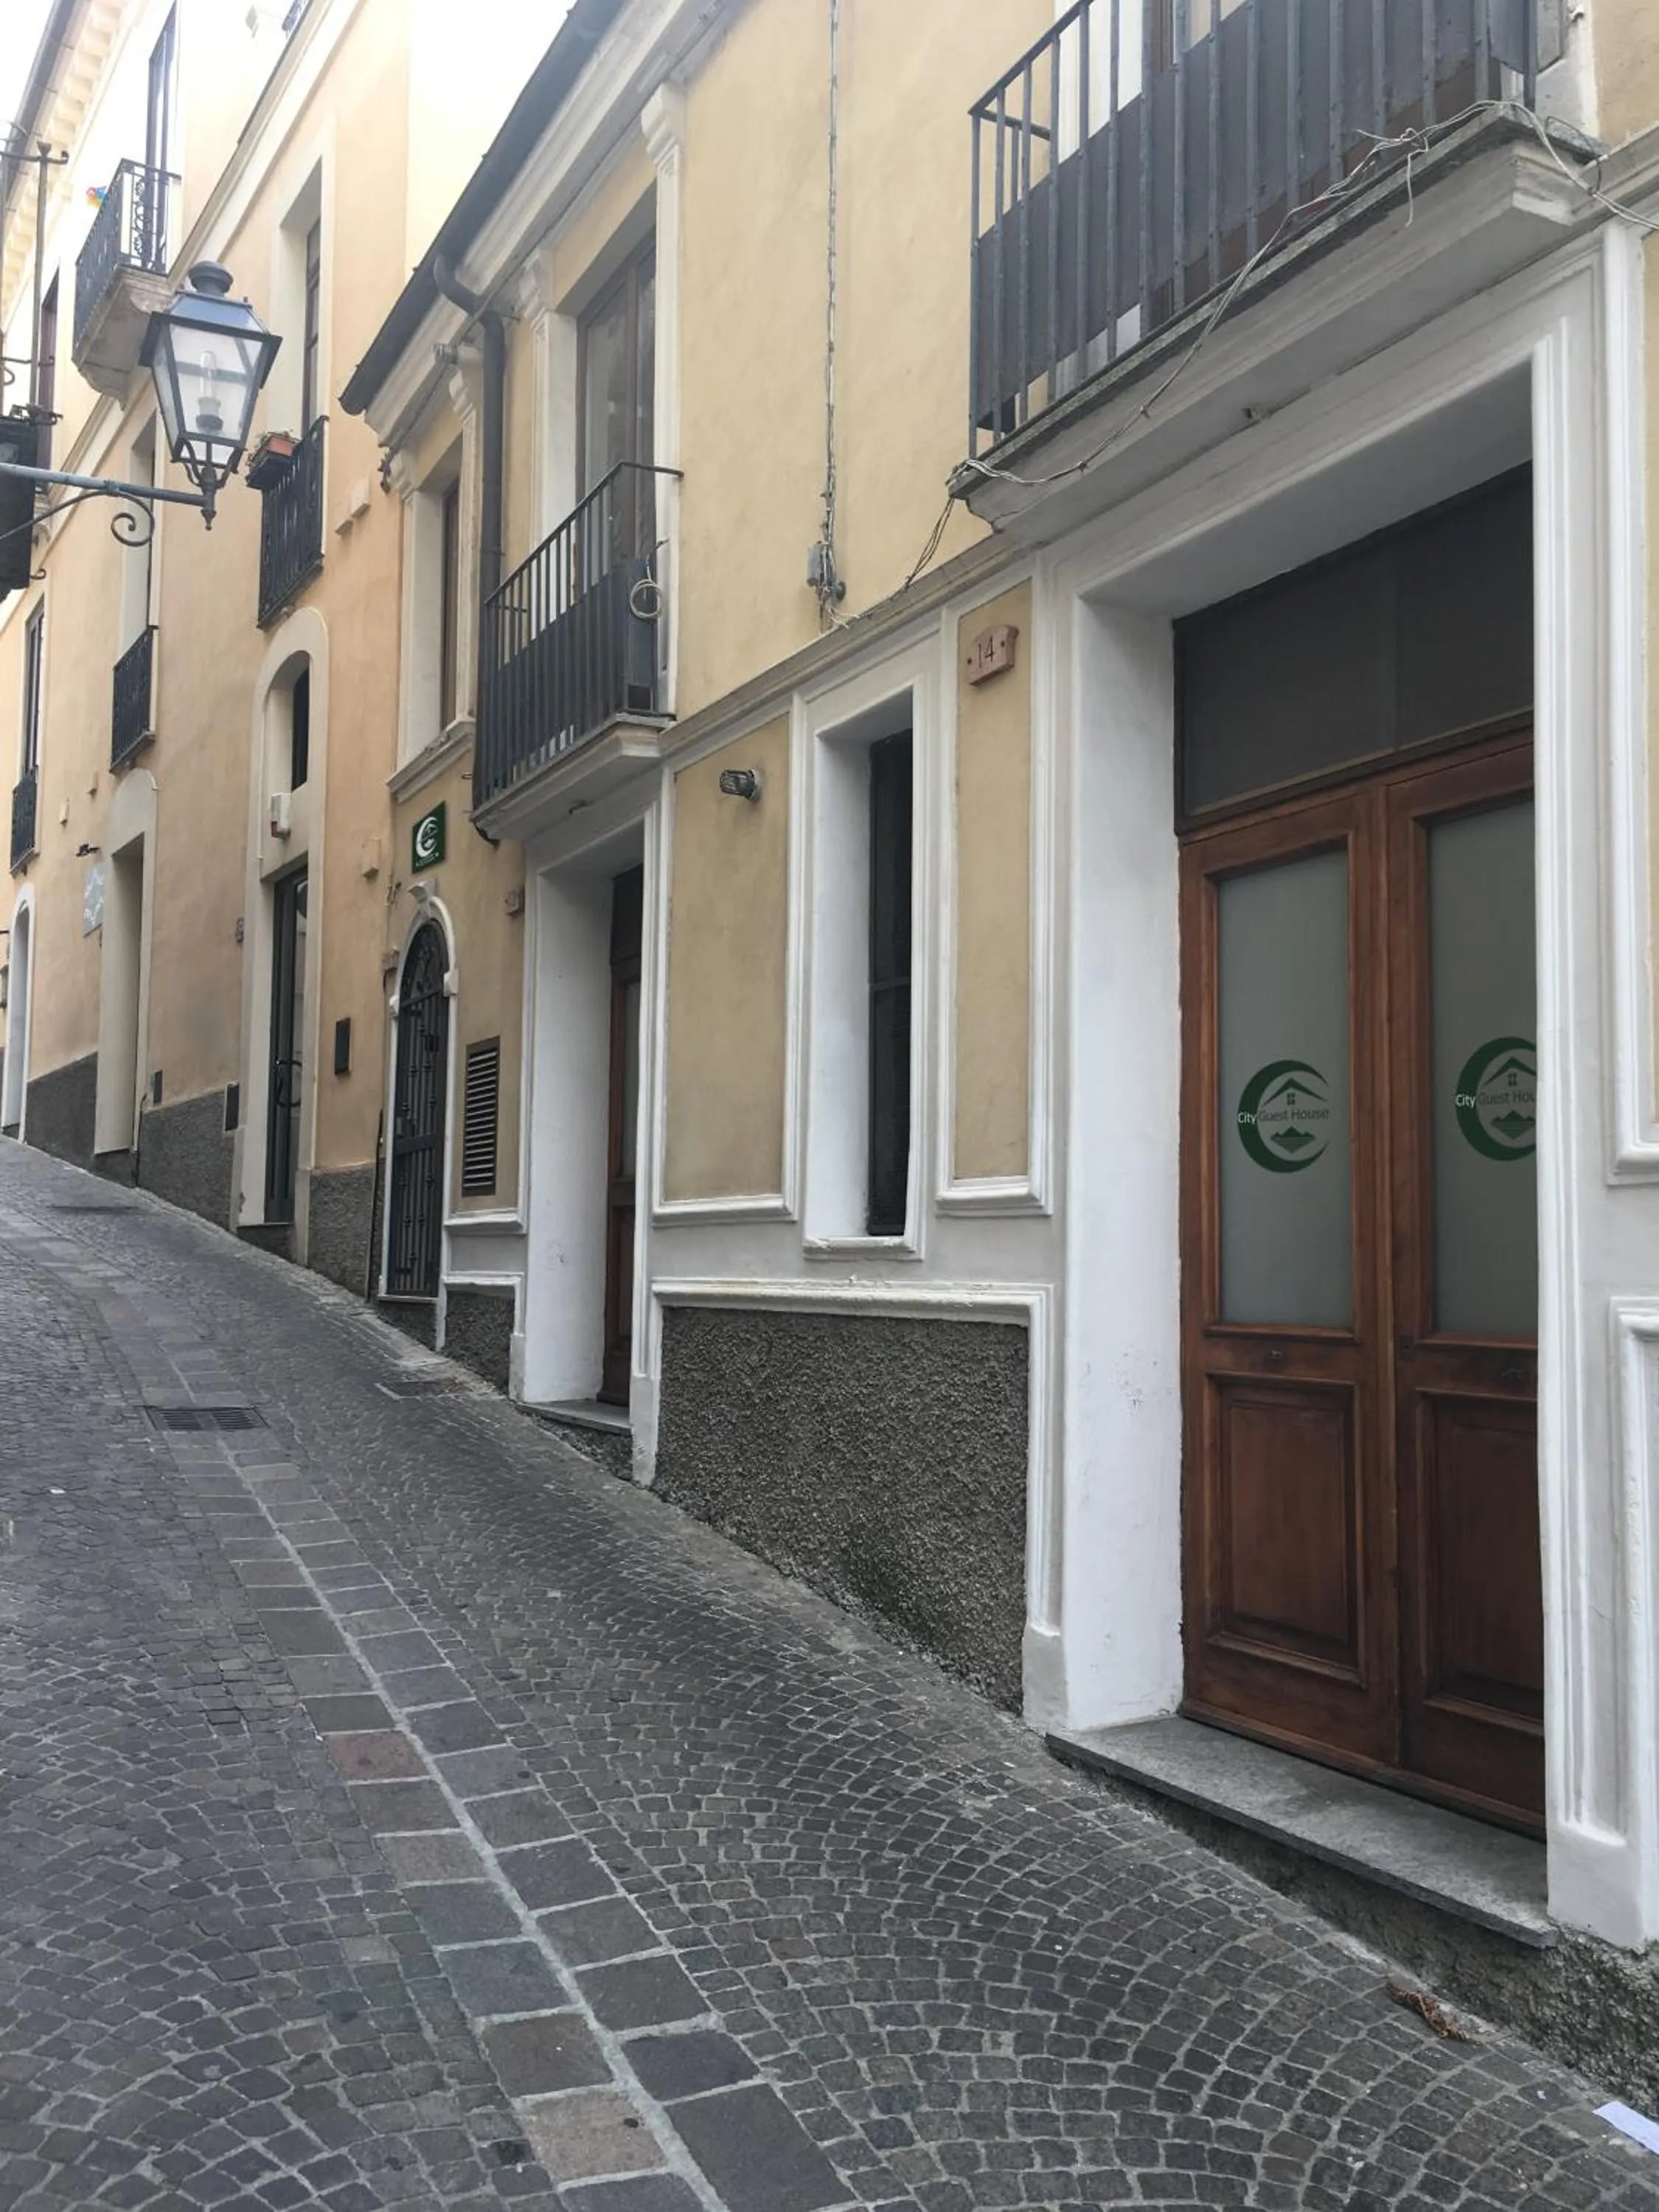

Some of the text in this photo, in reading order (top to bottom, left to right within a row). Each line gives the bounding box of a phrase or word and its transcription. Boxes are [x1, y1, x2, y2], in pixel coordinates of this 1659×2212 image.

[978, 635, 995, 668] 14
[1456, 1091, 1537, 1108] City Guest Hou
[1238, 1108, 1329, 1124] City Guest House
